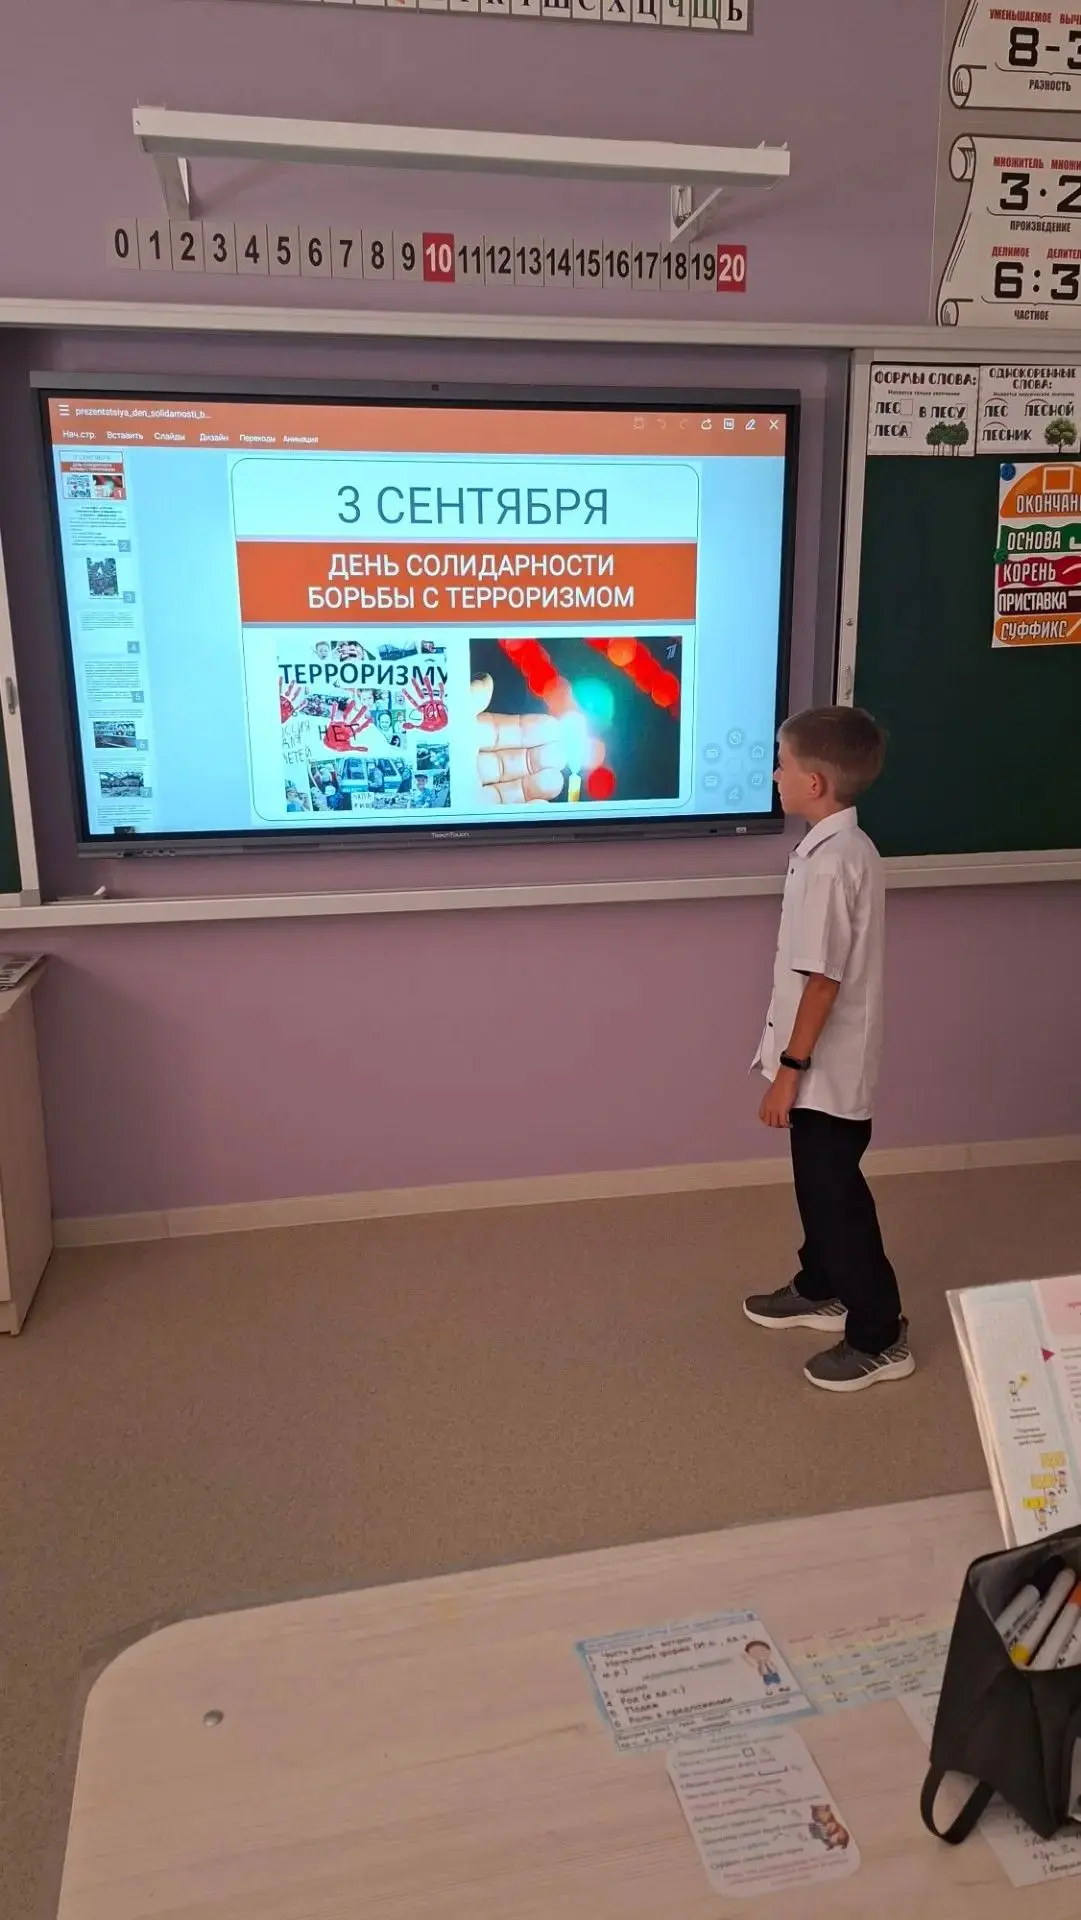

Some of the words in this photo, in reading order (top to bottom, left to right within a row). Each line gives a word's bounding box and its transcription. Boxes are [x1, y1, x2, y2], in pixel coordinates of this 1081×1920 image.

[693, 0, 719, 29] Щ
[990, 9, 1052, 23] УМЕНЬШАЕМОЕ
[1029, 79, 1071, 91] РАЗНОСТЬ
[993, 156, 1044, 169] МНОЖИТЕЛЬ
[1010, 220, 1071, 233] ПРОИЗВЕДЕНИЕ
[114, 229, 129, 258] 0
[149, 231, 160, 259] 1
[180, 232, 196, 261] 2
[213, 234, 228, 262] 3
[245, 235, 259, 264] 4
[277, 237, 291, 265] 5
[308, 238, 323, 266] 6
[339, 240, 353, 267] 7
[371, 241, 385, 269] 8
[402, 242, 416, 271] 9
[425, 243, 452, 273] 10
[458, 245, 481, 274] 11
[486, 246, 511, 274] 12
[516, 247, 542, 275] 13
[546, 248, 571, 276] 14
[576, 249, 600, 277] 15
[605, 250, 629, 277] 16
[634, 251, 659, 279] 17
[662, 252, 687, 279] 18
[691, 253, 715, 281] 19
[719, 254, 745, 282] 20
[991, 246, 1030, 258] ДЕЛИМОЕ
[1014, 310, 1049, 321] ЧАСТНОЕ
[874, 370, 925, 385] ФОРМЫ
[928, 372, 977, 386] СЛОВА:
[989, 368, 1077, 379] ОДНОКОРЕННЫЕ
[1013, 379, 1052, 389] СЛОВА:
[875, 401, 900, 414] ЛЕС
[919, 407, 927, 418] В
[930, 406, 966, 419] ЛЕСУ
[984, 405, 1009, 418] ЛЕС
[1024, 401, 1074, 417] ЛЕСНОЙ
[106, 431, 144, 440] Вставить
[153, 432, 186, 441] Слайды
[200, 433, 229, 442] Дизайн
[240, 434, 276, 443] Переходы
[283, 435, 319, 444] Анимация
[873, 424, 908, 437] ЛЕСА
[982, 429, 1032, 441] ЛЕСНИК
[338, 486, 361, 523] 3
[377, 487, 608, 525] СЕНТЯБРЯ
[1017, 494, 1081, 513] ОКОНЧАН
[1008, 531, 1061, 550] ОСНОВА
[328, 553, 399, 580] ДЕНЬ
[406, 554, 615, 580] СОЛИДАРНОСТИ
[1003, 563, 1056, 582] КОРЕНЬ
[308, 586, 415, 609] БОРЬБЫ
[422, 587, 439, 608] С
[446, 587, 635, 608] ТЕРРОРИЗМОМ
[999, 591, 1067, 611] ПРИСТАВКА
[1001, 621, 1067, 641] СУФФИКС
[318, 723, 360, 742] НЕТ
